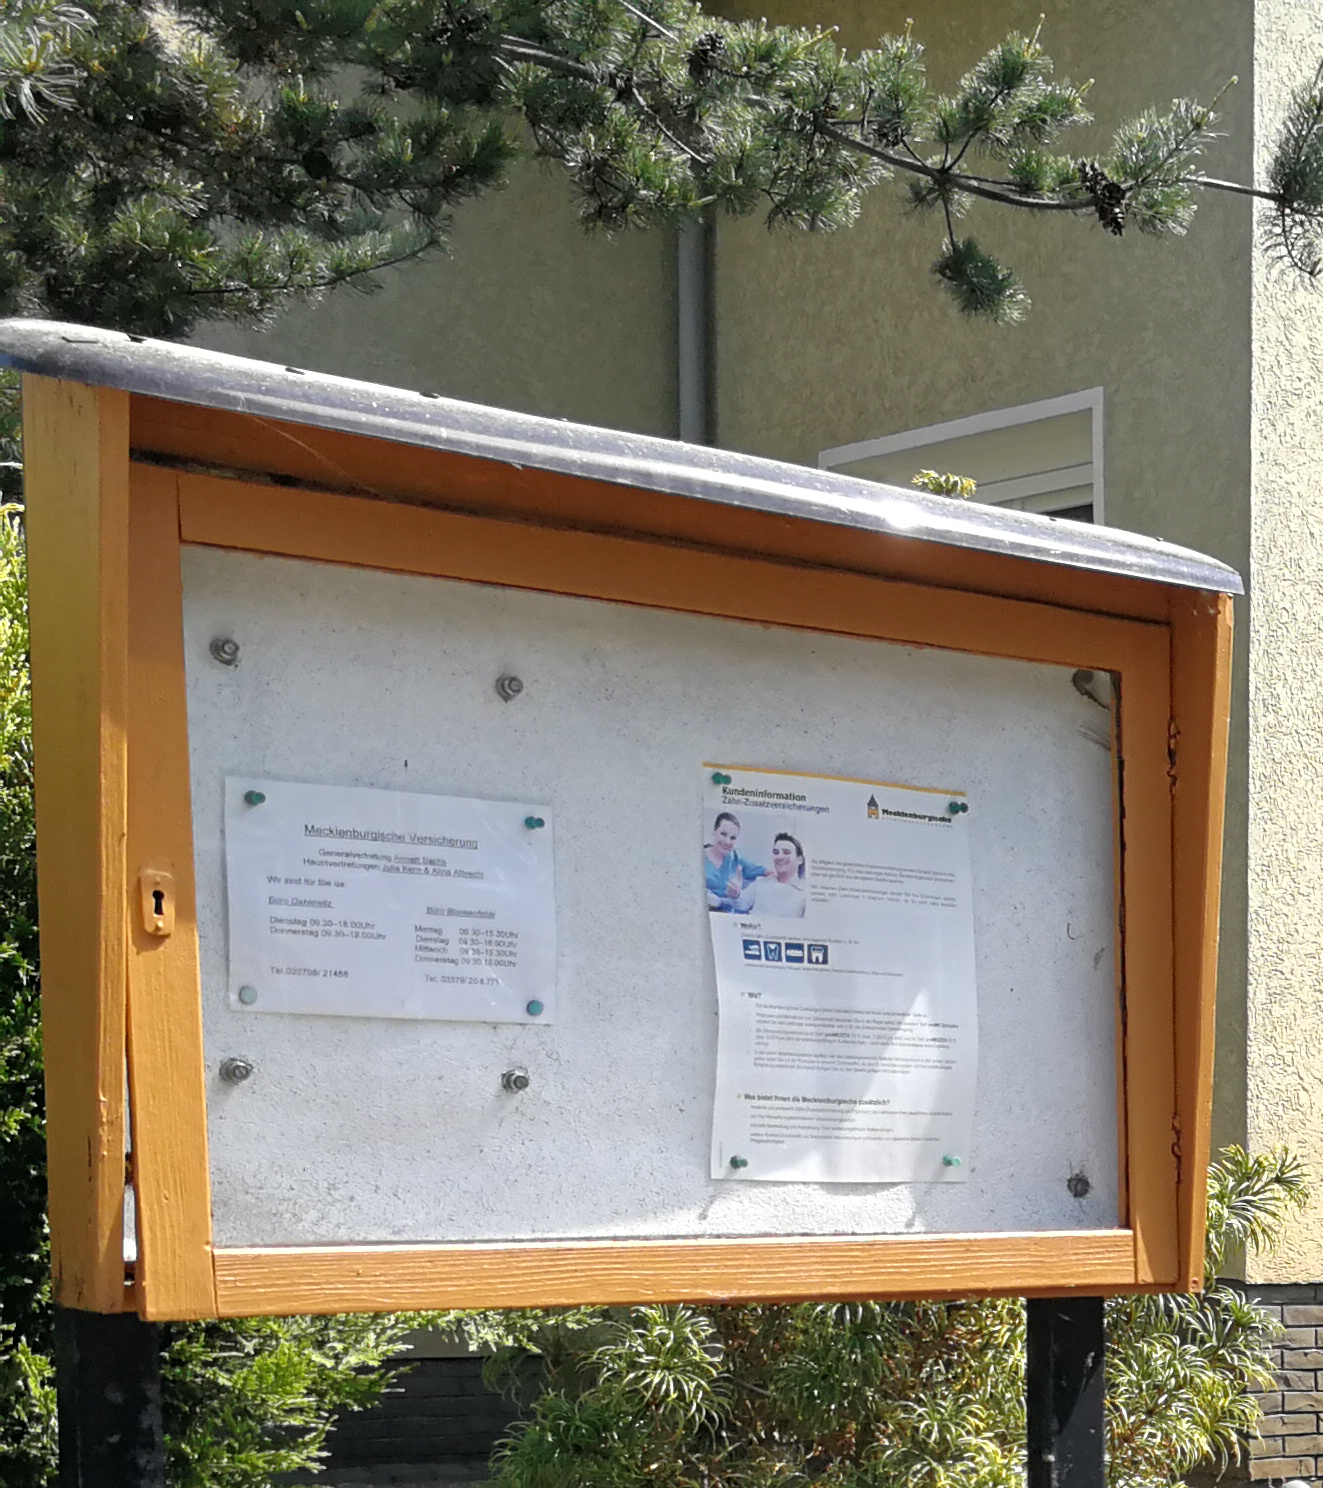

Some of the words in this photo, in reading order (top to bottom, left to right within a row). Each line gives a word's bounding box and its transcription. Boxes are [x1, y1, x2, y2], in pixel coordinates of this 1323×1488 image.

[722, 786, 807, 802] Kundeninformation
[722, 796, 830, 814] Zahn-Zusatzversicherungen
[882, 808, 952, 823] Mecklenburgische
[304, 823, 405, 845] Mecklenburgische
[409, 832, 479, 850] Versicherung
[318, 848, 392, 863] Generalvertretung
[303, 857, 380, 872] Hauptvertretungen
[267, 875, 281, 883] Wir
[304, 878, 316, 886] für
[268, 896, 289, 905] Büro
[270, 916, 307, 926] Dienstag
[270, 926, 318, 938] Donnerstag
[416, 935, 449, 945] Dienstag
[415, 955, 459, 966] Donnerstag
[801, 1097, 857, 1106] Mecklenburgische
